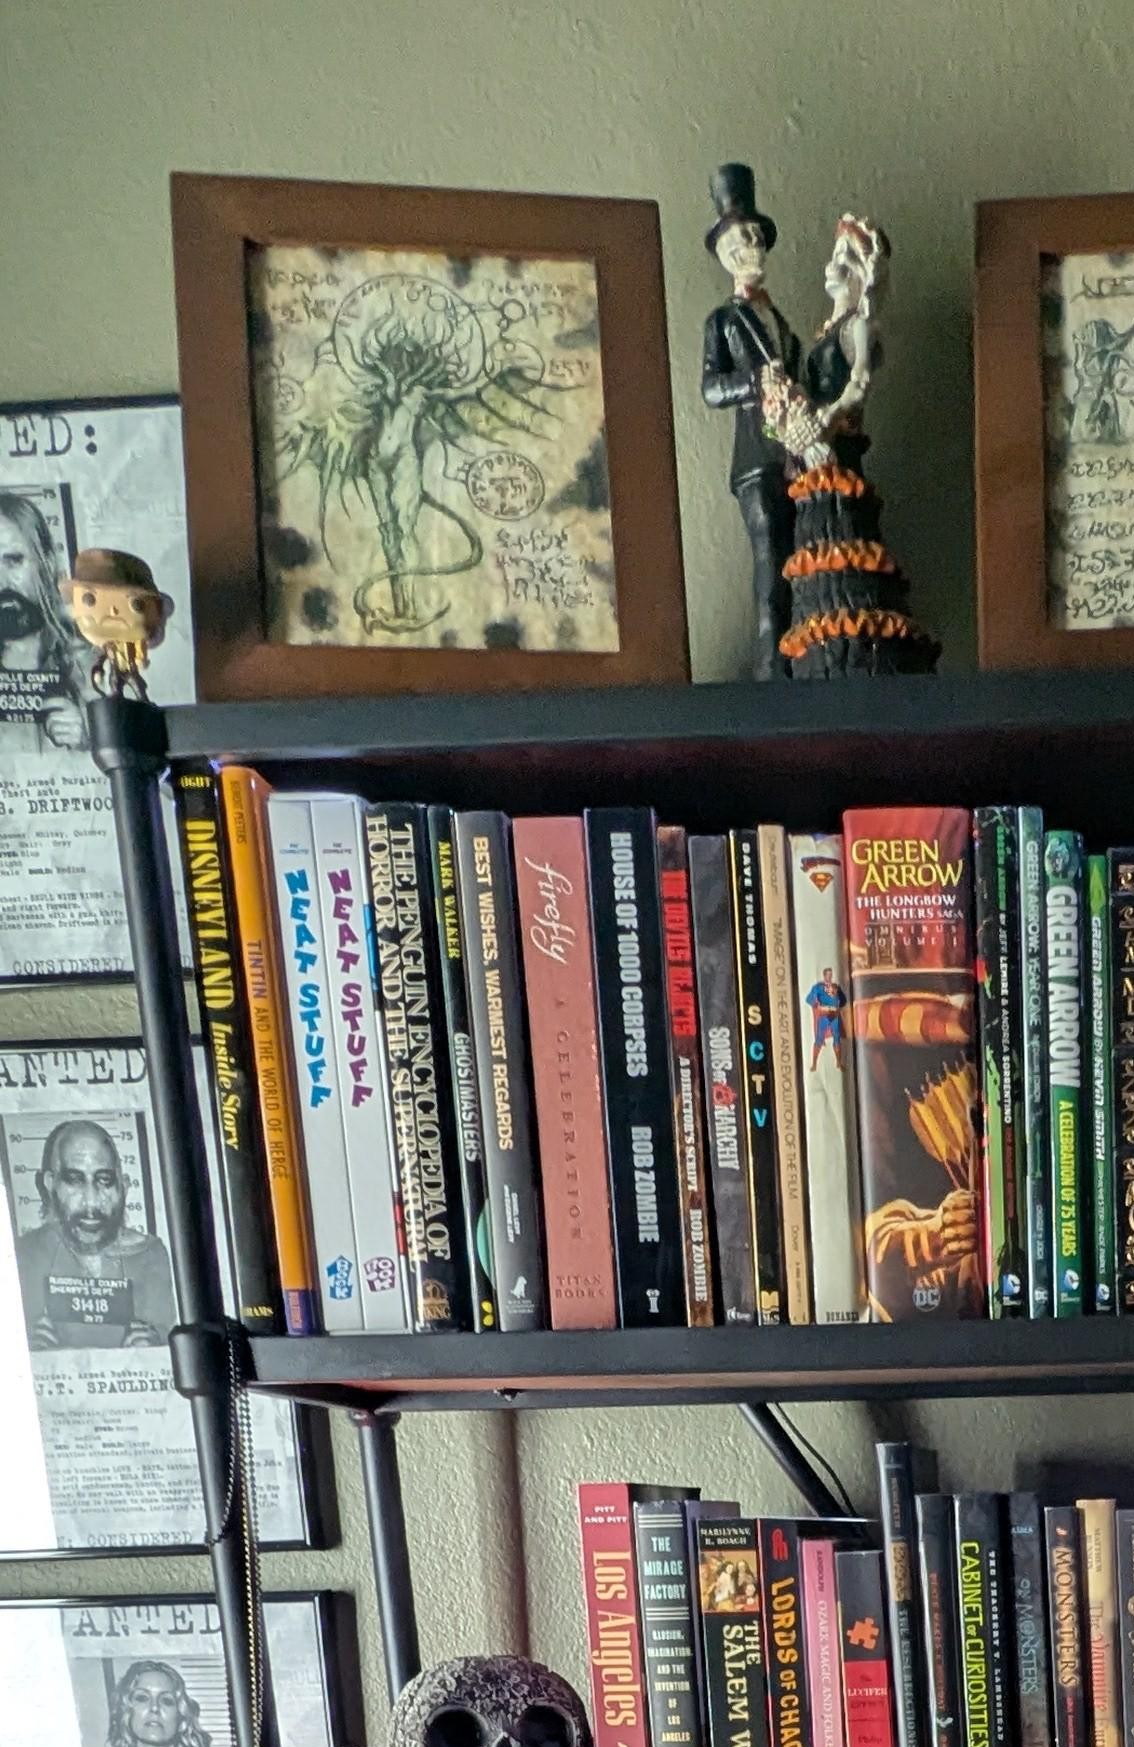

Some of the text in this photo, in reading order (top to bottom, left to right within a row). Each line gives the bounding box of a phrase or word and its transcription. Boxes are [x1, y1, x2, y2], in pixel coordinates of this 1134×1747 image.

[438, 841, 462, 959] MARK WALKER
[472, 836, 492, 885] BEST
[851, 837, 939, 867] GREEN
[860, 860, 964, 893] ARROW
[185, 820, 236, 1011] DISNEYLAND
[610, 832, 649, 1078] HOUSE 1000 CORPSES
[247, 940, 281, 1112] TINTIN WORLD
[284, 869, 332, 1109] NEAT STUFF
[327, 869, 373, 1108] NEAT STUFF
[484, 969, 507, 1057] WARMEST
[1045, 885, 1081, 1089] GREEN ARROW
[209, 1021, 241, 1150] Inside Story
[395, 889, 448, 1219] PENGUIN ENCYCLOPEDIA
[453, 1032, 482, 1163] GHOSTMASTERS
[491, 1062, 514, 1151] REGARDS
[631, 1126, 660, 1243] ROB ZOMBIE
[71, 1297, 109, 1313] 31418
[644, 1561, 683, 1575] MIRAGE
[644, 1585, 686, 1599] FACTORY
[651, 1536, 671, 1552] THE
[959, 1541, 983, 1623] CABINET
[770, 1577, 799, 1663] LORDS
[1055, 1550, 1080, 1687] MONSTERS
[722, 1625, 746, 1720] SALEM
